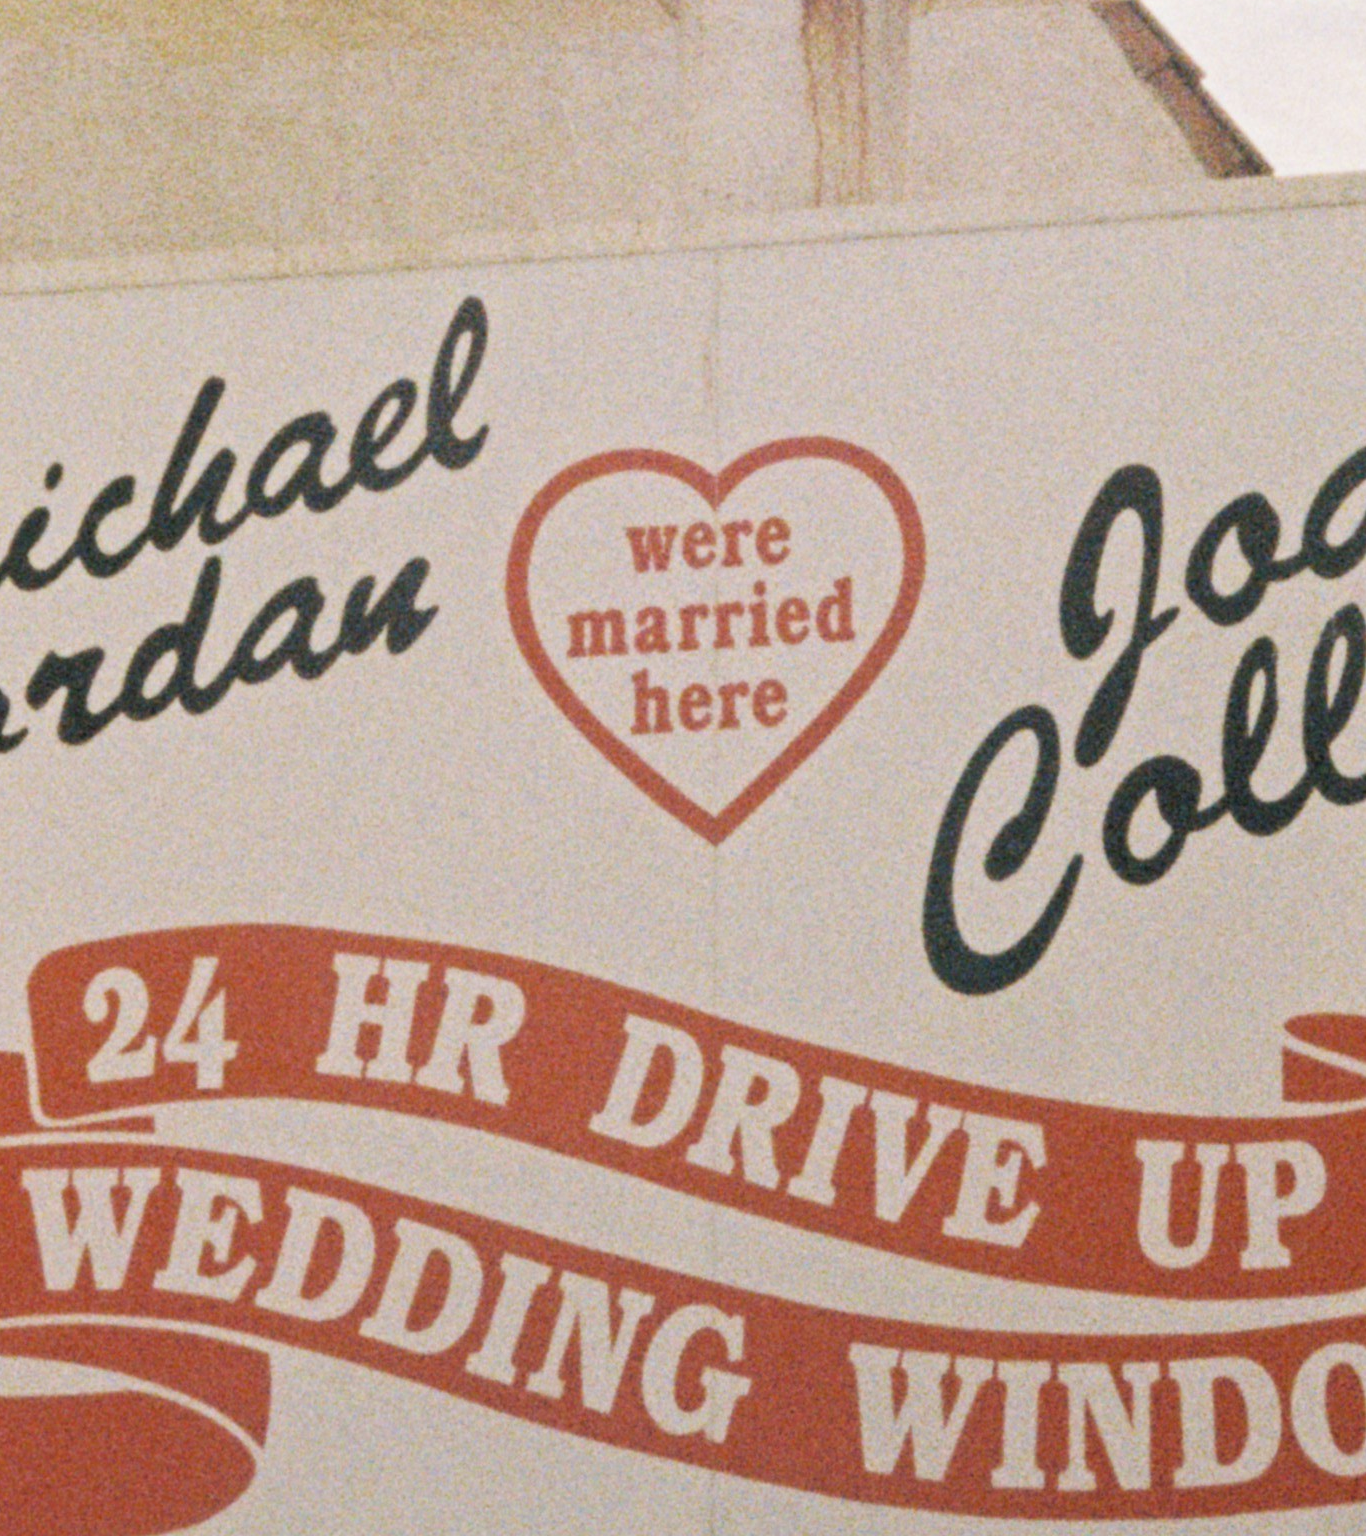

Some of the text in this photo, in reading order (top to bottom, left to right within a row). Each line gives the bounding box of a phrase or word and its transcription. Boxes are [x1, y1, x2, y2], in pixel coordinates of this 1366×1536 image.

[626, 516, 792, 573] were
[566, 576, 855, 658] married
[630, 668, 788, 735] here
[82, 952, 1326, 1269] 24 HR DRIVE UP
[22, 1166, 751, 1444] WEDDING
